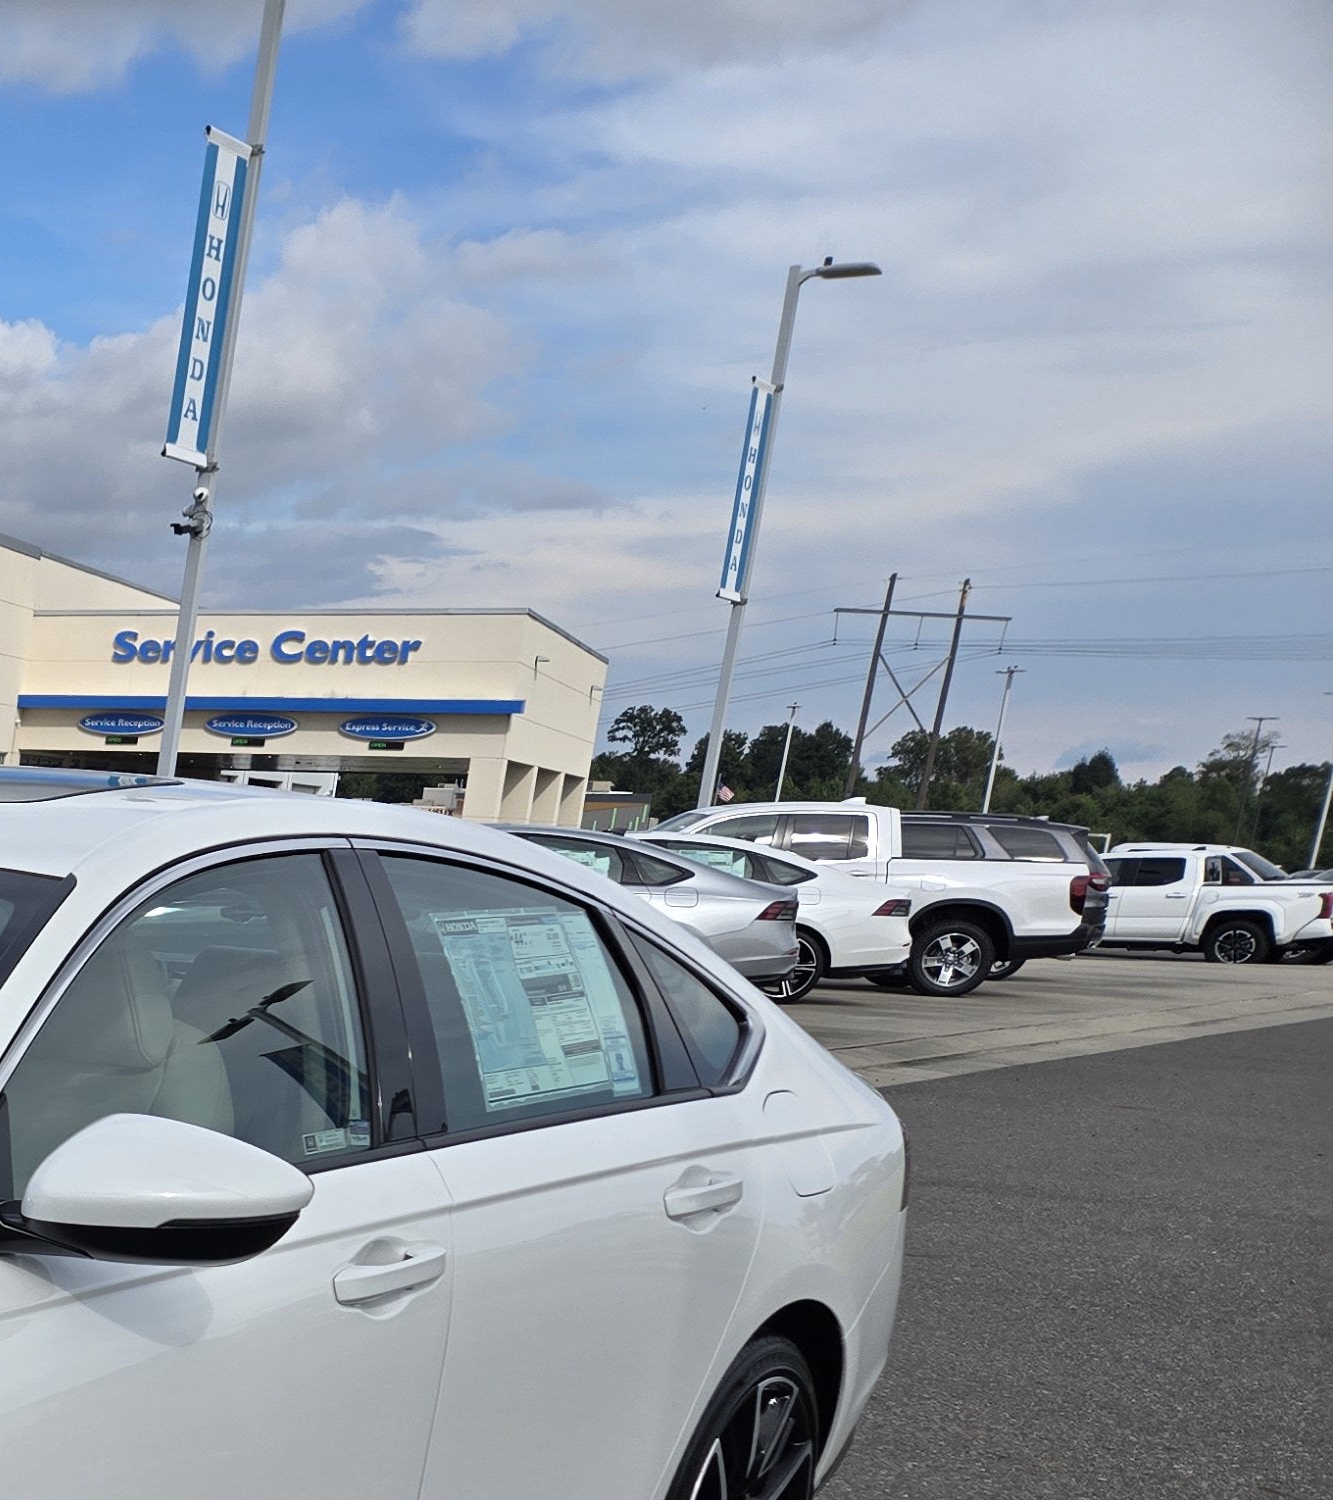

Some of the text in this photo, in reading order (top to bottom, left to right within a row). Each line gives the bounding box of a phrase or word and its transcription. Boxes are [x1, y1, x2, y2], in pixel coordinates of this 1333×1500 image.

[183, 234, 224, 422] HONDA
[729, 447, 758, 572] HONDA
[271, 629, 424, 666] Center
[84, 717, 161, 729] Service Reception
[212, 718, 292, 730] Service Reception
[345, 721, 416, 733] Express Service
